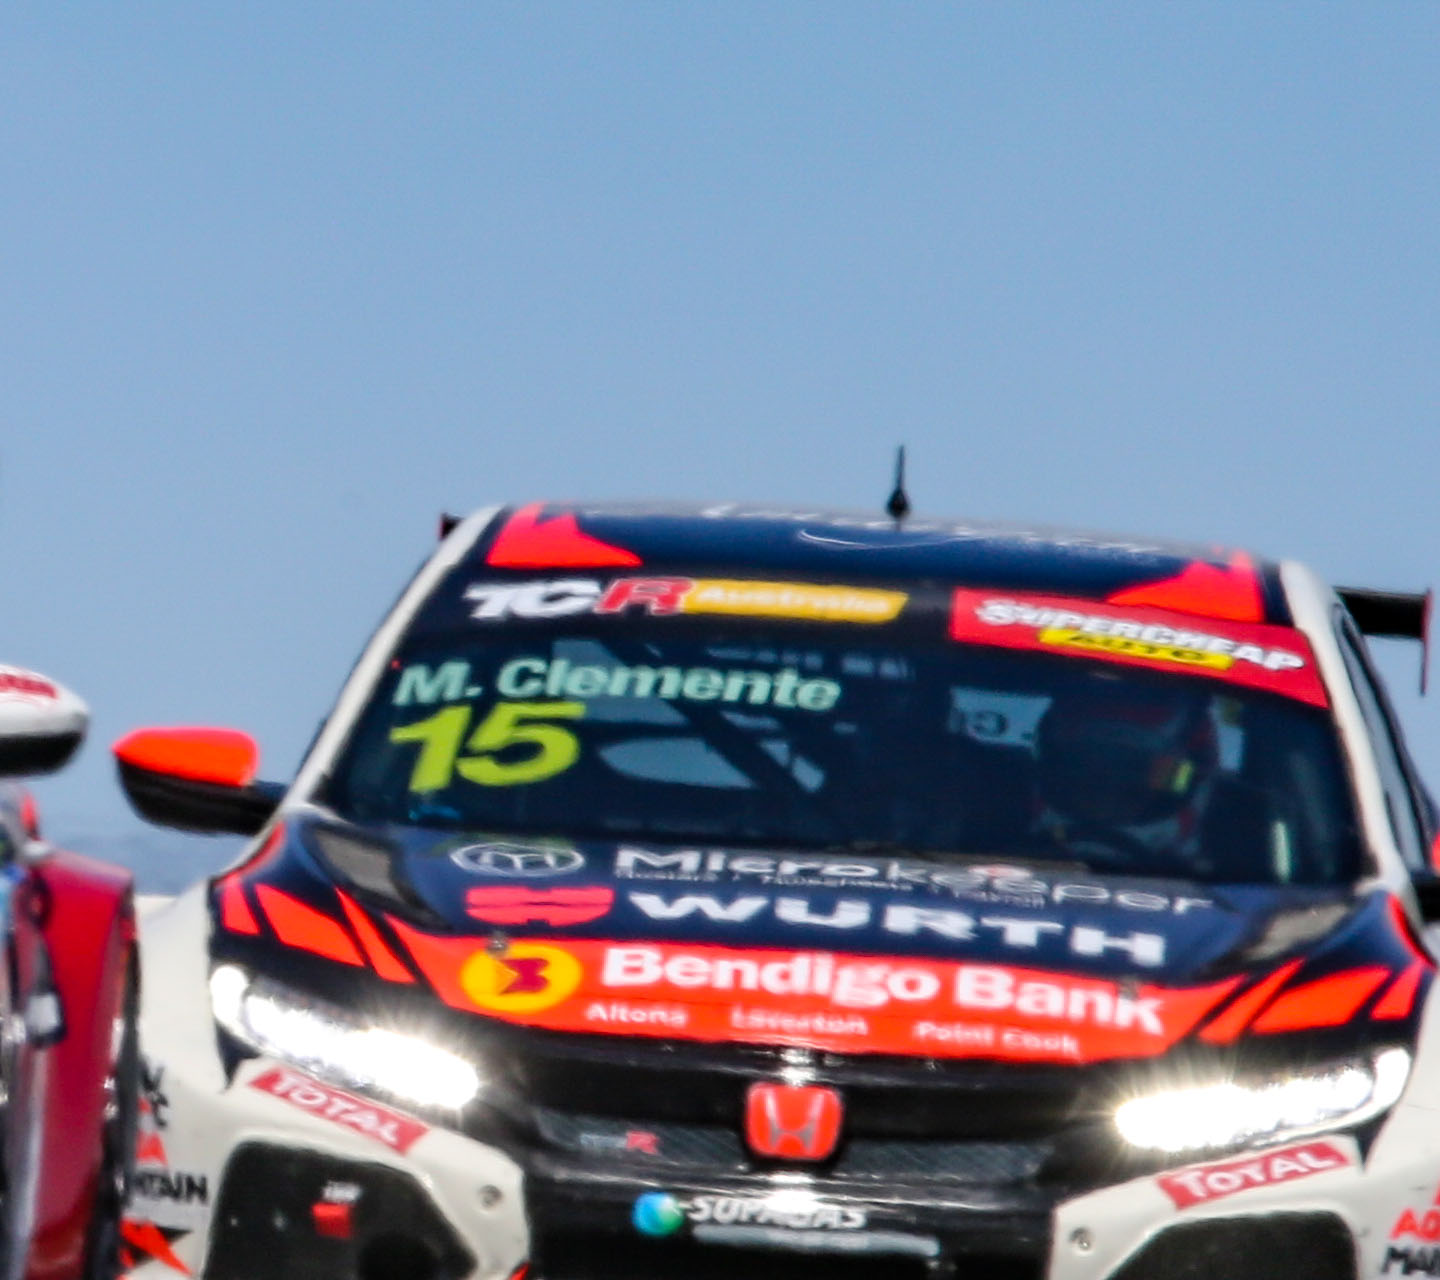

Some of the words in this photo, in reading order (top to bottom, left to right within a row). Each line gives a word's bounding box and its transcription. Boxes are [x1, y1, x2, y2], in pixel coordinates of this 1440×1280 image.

[464, 577, 694, 619] TCR
[975, 598, 1306, 672] SUPERCHEAP
[393, 661, 484, 707] M.
[496, 657, 843, 712] Clemente
[389, 700, 588, 794] 15
[585, 1002, 689, 1030] Altona
[602, 946, 940, 1008] Bendigo
[954, 965, 1165, 1036] Bank
